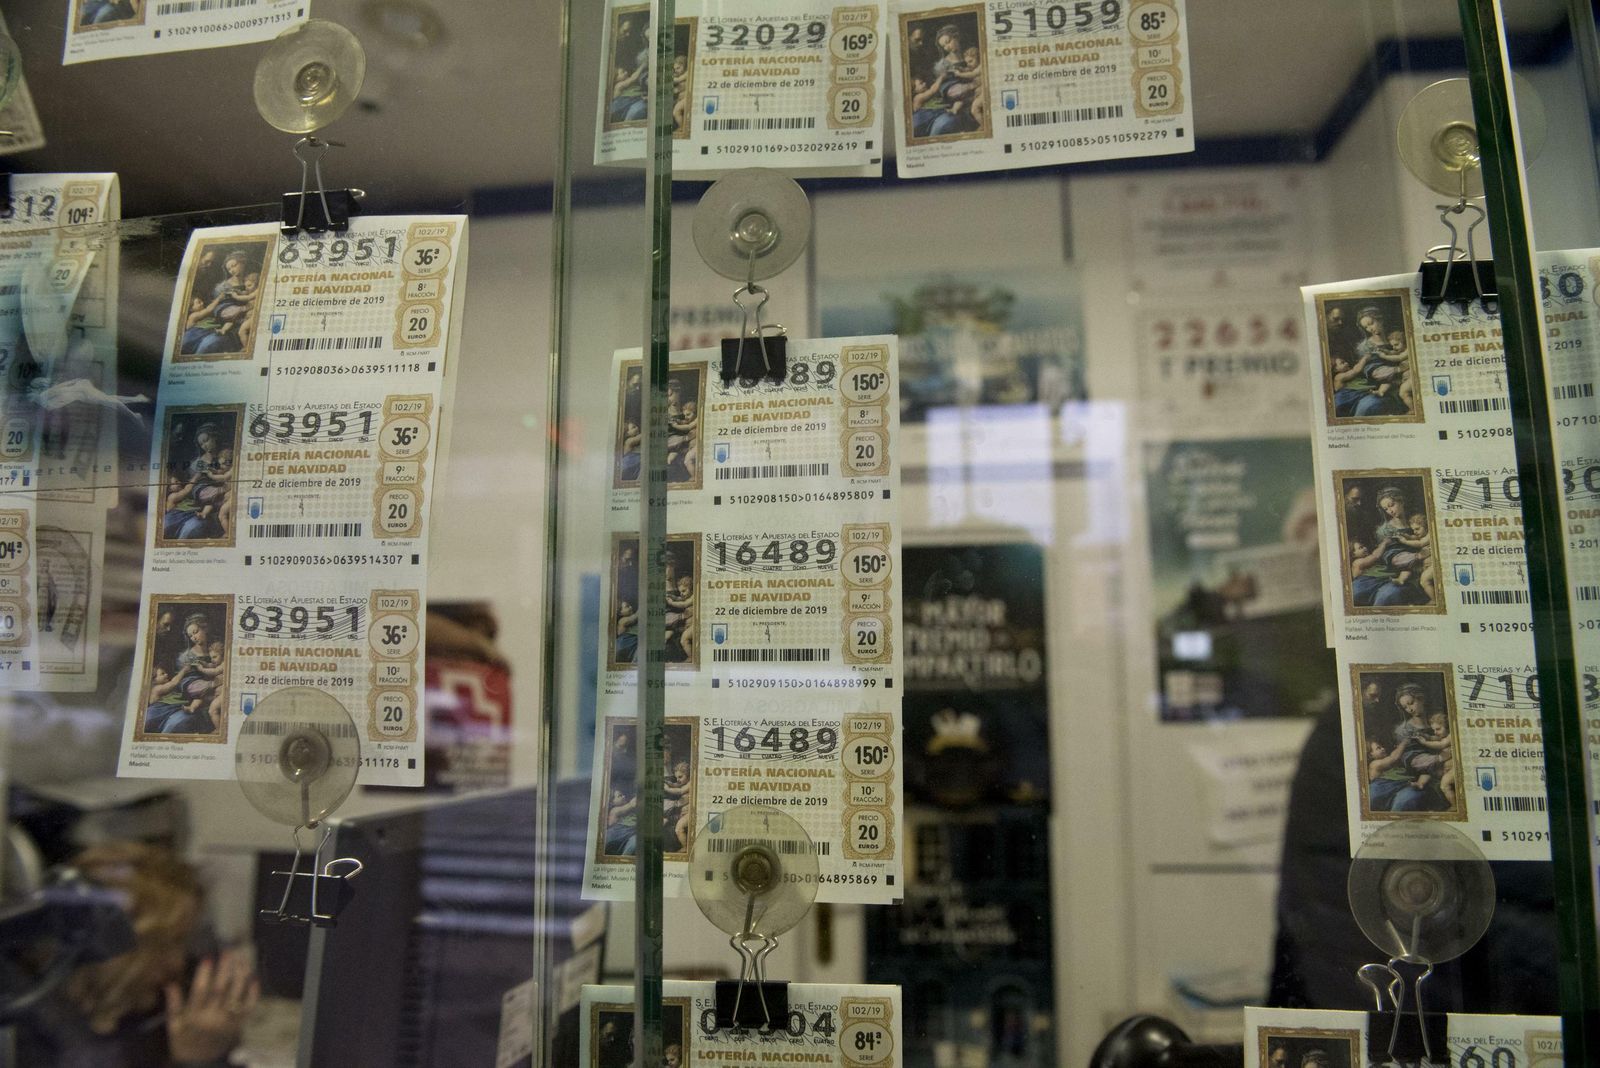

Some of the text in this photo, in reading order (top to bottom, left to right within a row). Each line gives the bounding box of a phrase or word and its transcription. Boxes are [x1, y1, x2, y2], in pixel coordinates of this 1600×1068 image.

[995, 0, 1121, 35] 51059
[706, 22, 826, 47] 32029
[995, 37, 1122, 57] LOTERÍA NACIONAL
[702, 54, 822, 65] LOTERÍA NACIONAL
[1019, 53, 1099, 68] DE NAVIDAD
[722, 68, 799, 77] DE NAVIDAD
[1004, 64, 1116, 82] 22 de diciembre de 2019
[794, 79, 815, 87] 2019
[1148, 85, 1167, 99] 20
[842, 100, 860, 112] 20
[279, 237, 397, 264] 63951
[274, 271, 394, 284] LOTERÍA NACIONAL
[292, 285, 371, 295] DE NAVIDAD
[303, 298, 347, 306] diciembre
[364, 296, 384, 305] 2019
[409, 317, 427, 331] 20
[1423, 328, 1486, 342] LOTERÍA
[1451, 345, 1469, 354] DE
[812, 352, 839, 360] ESTADO
[852, 352, 878, 360] 102/19
[1435, 358, 1463, 367] 22 de
[277, 364, 420, 375] 5102908036>0639511118
[712, 397, 833, 412] LOTERÍA NACIONAL
[732, 411, 811, 423] DE NAVIDAD
[250, 411, 372, 438] 63951
[718, 423, 826, 436] 22 de diciembre de 2019
[247, 449, 370, 461] LOTERÍA NACIONAL
[856, 445, 874, 458] 20
[268, 464, 346, 475] DE NAVIDAD
[252, 480, 262, 488] 22
[266, 480, 276, 488] de
[279, 479, 322, 487] diciembre
[339, 478, 361, 486] 2019
[730, 491, 874, 504] 5102908150>0164895809
[388, 504, 407, 519] 20
[1445, 515, 1508, 528] LOTERÍA
[722, 533, 752, 541] LOTERÍAS
[762, 532, 796, 540] APUESTAS
[852, 532, 879, 540] 102/19
[1472, 532, 1492, 541] DE
[714, 539, 836, 566] 16489
[1456, 546, 1468, 555] 22
[260, 555, 403, 565] 5102909036>0639514307
[708, 578, 834, 589] LOTERÍA NACIONAL
[339, 596, 367, 604] ESTADO
[730, 592, 811, 602] DE NAVIDAD
[381, 599, 408, 608] 102/19
[729, 607, 740, 615] de
[743, 607, 788, 615] diciembre
[805, 606, 827, 614] 2019
[240, 606, 359, 633] 63951
[857, 631, 876, 645] 20
[239, 645, 361, 657] LOTERÍA NACIONAL
[260, 662, 337, 672] DE NAVIDAD
[1478, 665, 1512, 673] LOTERÍAS
[245, 676, 354, 686] 22 de diciembre 2019
[728, 678, 876, 688] 5102909150>0164898999
[384, 707, 402, 722] 20
[761, 719, 796, 727] APUESTAS
[812, 719, 840, 727] ESTADO
[1467, 716, 1532, 728] LOTERÍA
[712, 727, 837, 753] 16489
[1495, 734, 1514, 743] DE
[1479, 749, 1491, 758] 22
[705, 765, 835, 778] LOTERÍA NACIONAL
[728, 782, 811, 792] DE NAVIDAD
[712, 796, 723, 804] 22
[726, 796, 738, 804] de
[741, 796, 788, 805] diciembre
[791, 797, 802, 805] de
[858, 825, 878, 840] 20
[852, 1006, 881, 1015] 102/19
[698, 1048, 832, 1063] LOTERÍA NACIONAL
